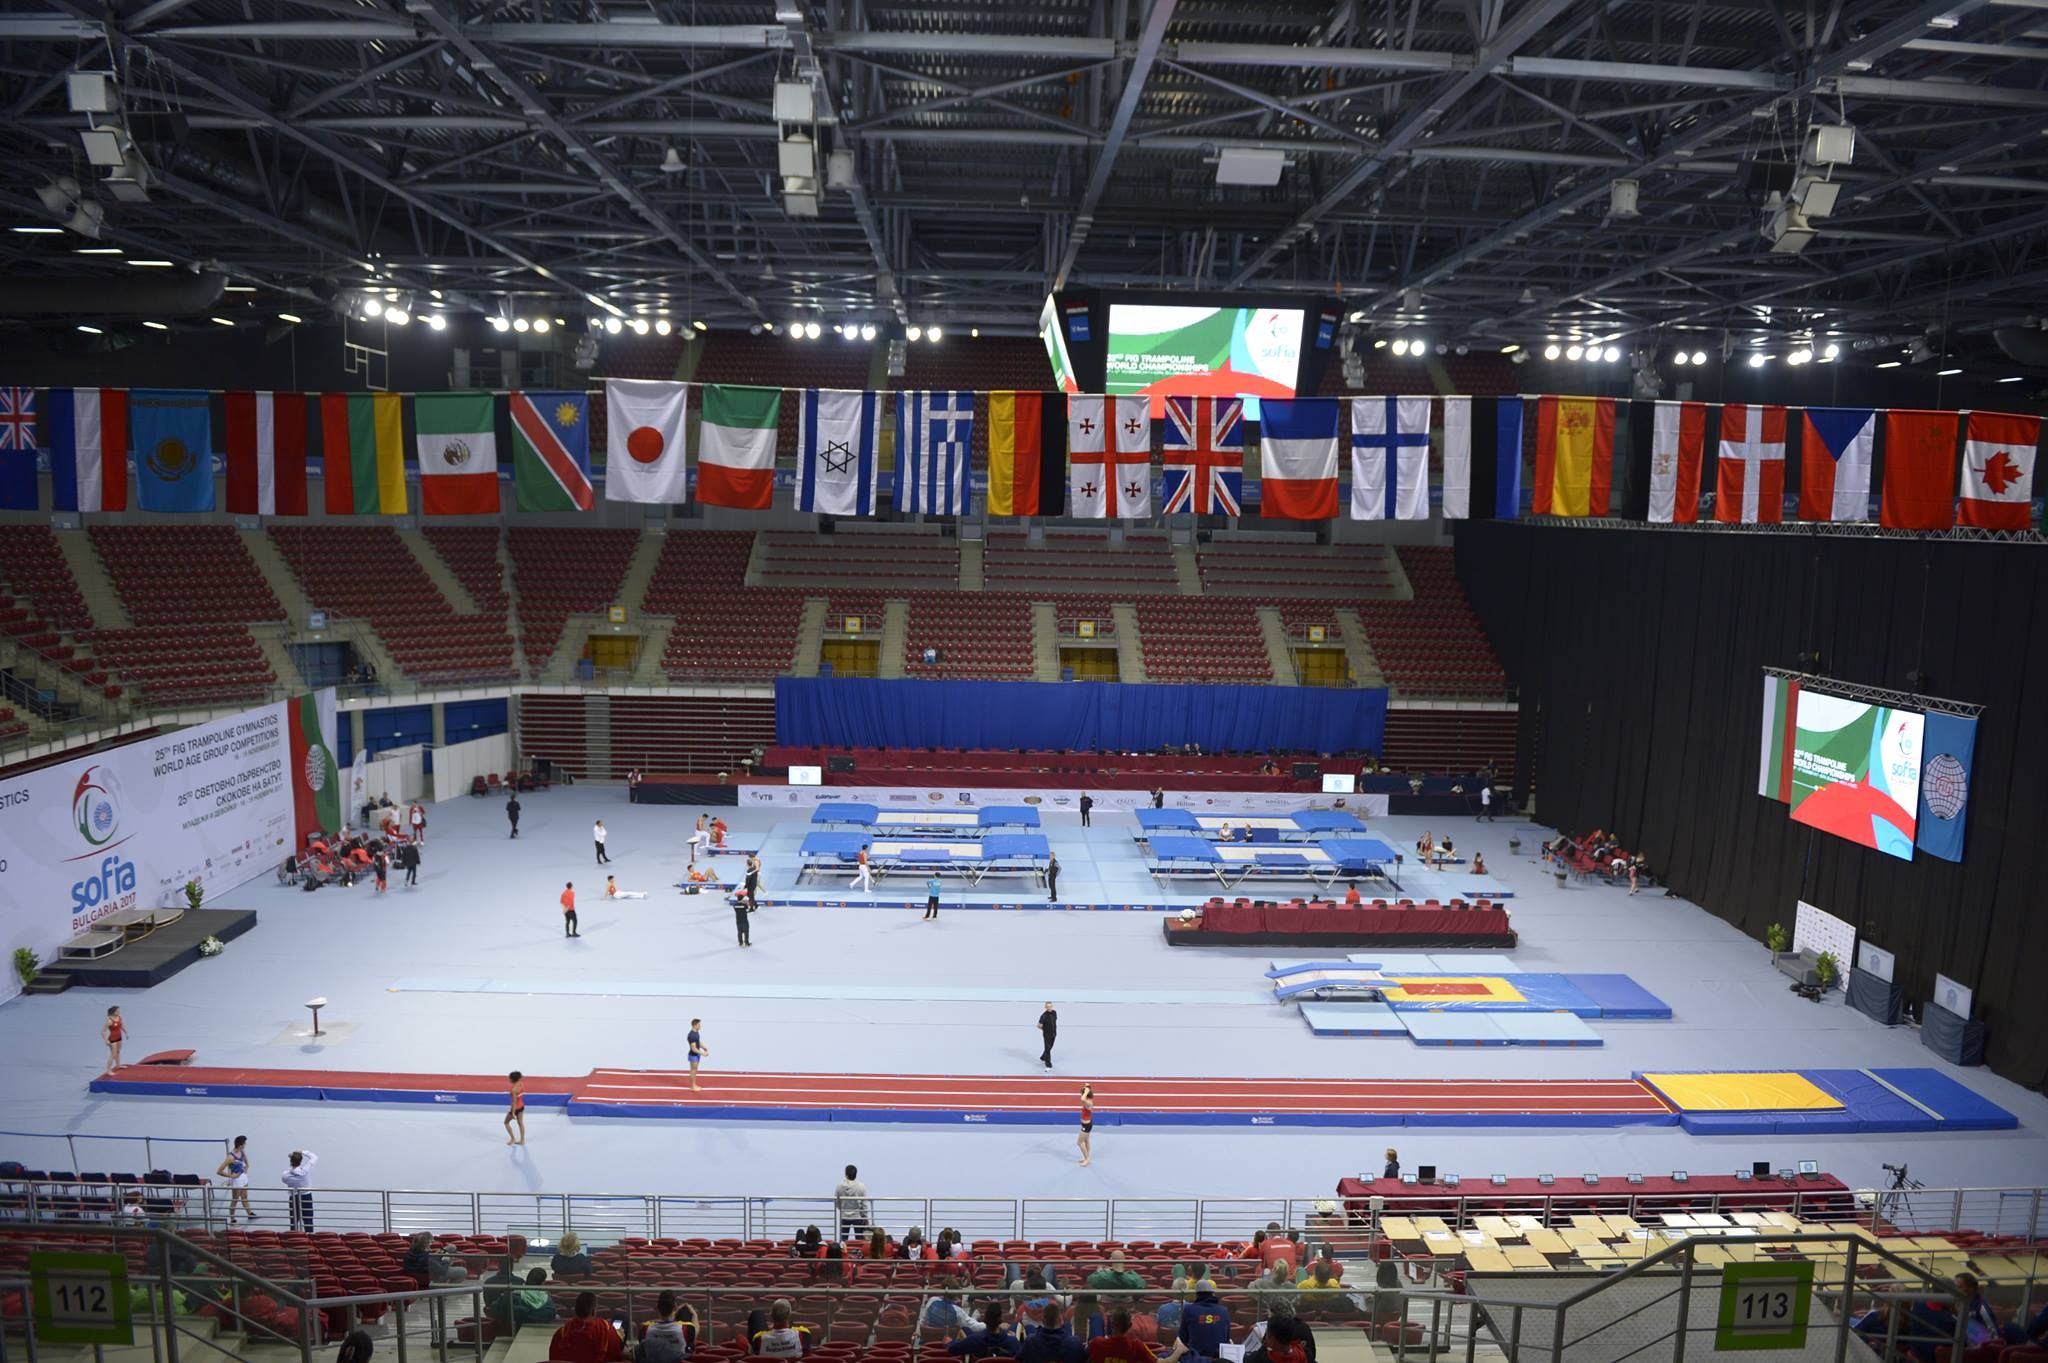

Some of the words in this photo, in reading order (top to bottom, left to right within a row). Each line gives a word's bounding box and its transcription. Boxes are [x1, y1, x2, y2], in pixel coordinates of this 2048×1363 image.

[1107, 362, 1138, 370] WORLD
[1141, 354, 1195, 364] TRAMPOLINE
[172, 743, 186, 756] FIG
[187, 728, 235, 751] TRAMPOLINE
[236, 714, 278, 736] GYMNASTICS
[153, 759, 184, 777] WORLD
[185, 753, 201, 768] AGE
[203, 744, 229, 761] GROUP
[230, 728, 279, 752] COMPETITIONS
[194, 777, 235, 800] СВЕТОВНО
[237, 759, 281, 784] ПЪРВЕНСТВО
[1891, 761, 1917, 781] sofia
[216, 785, 251, 807] СКОКОВЕ
[263, 772, 282, 788] БАТУТ
[71, 855, 136, 914] sofia
[72, 901, 119, 931] BULGARIA
[120, 892, 136, 909] 2017
[56, 1284, 107, 1313] 112
[1742, 1292, 1788, 1320] 113
[1199, 1314, 1221, 1324] ESP
